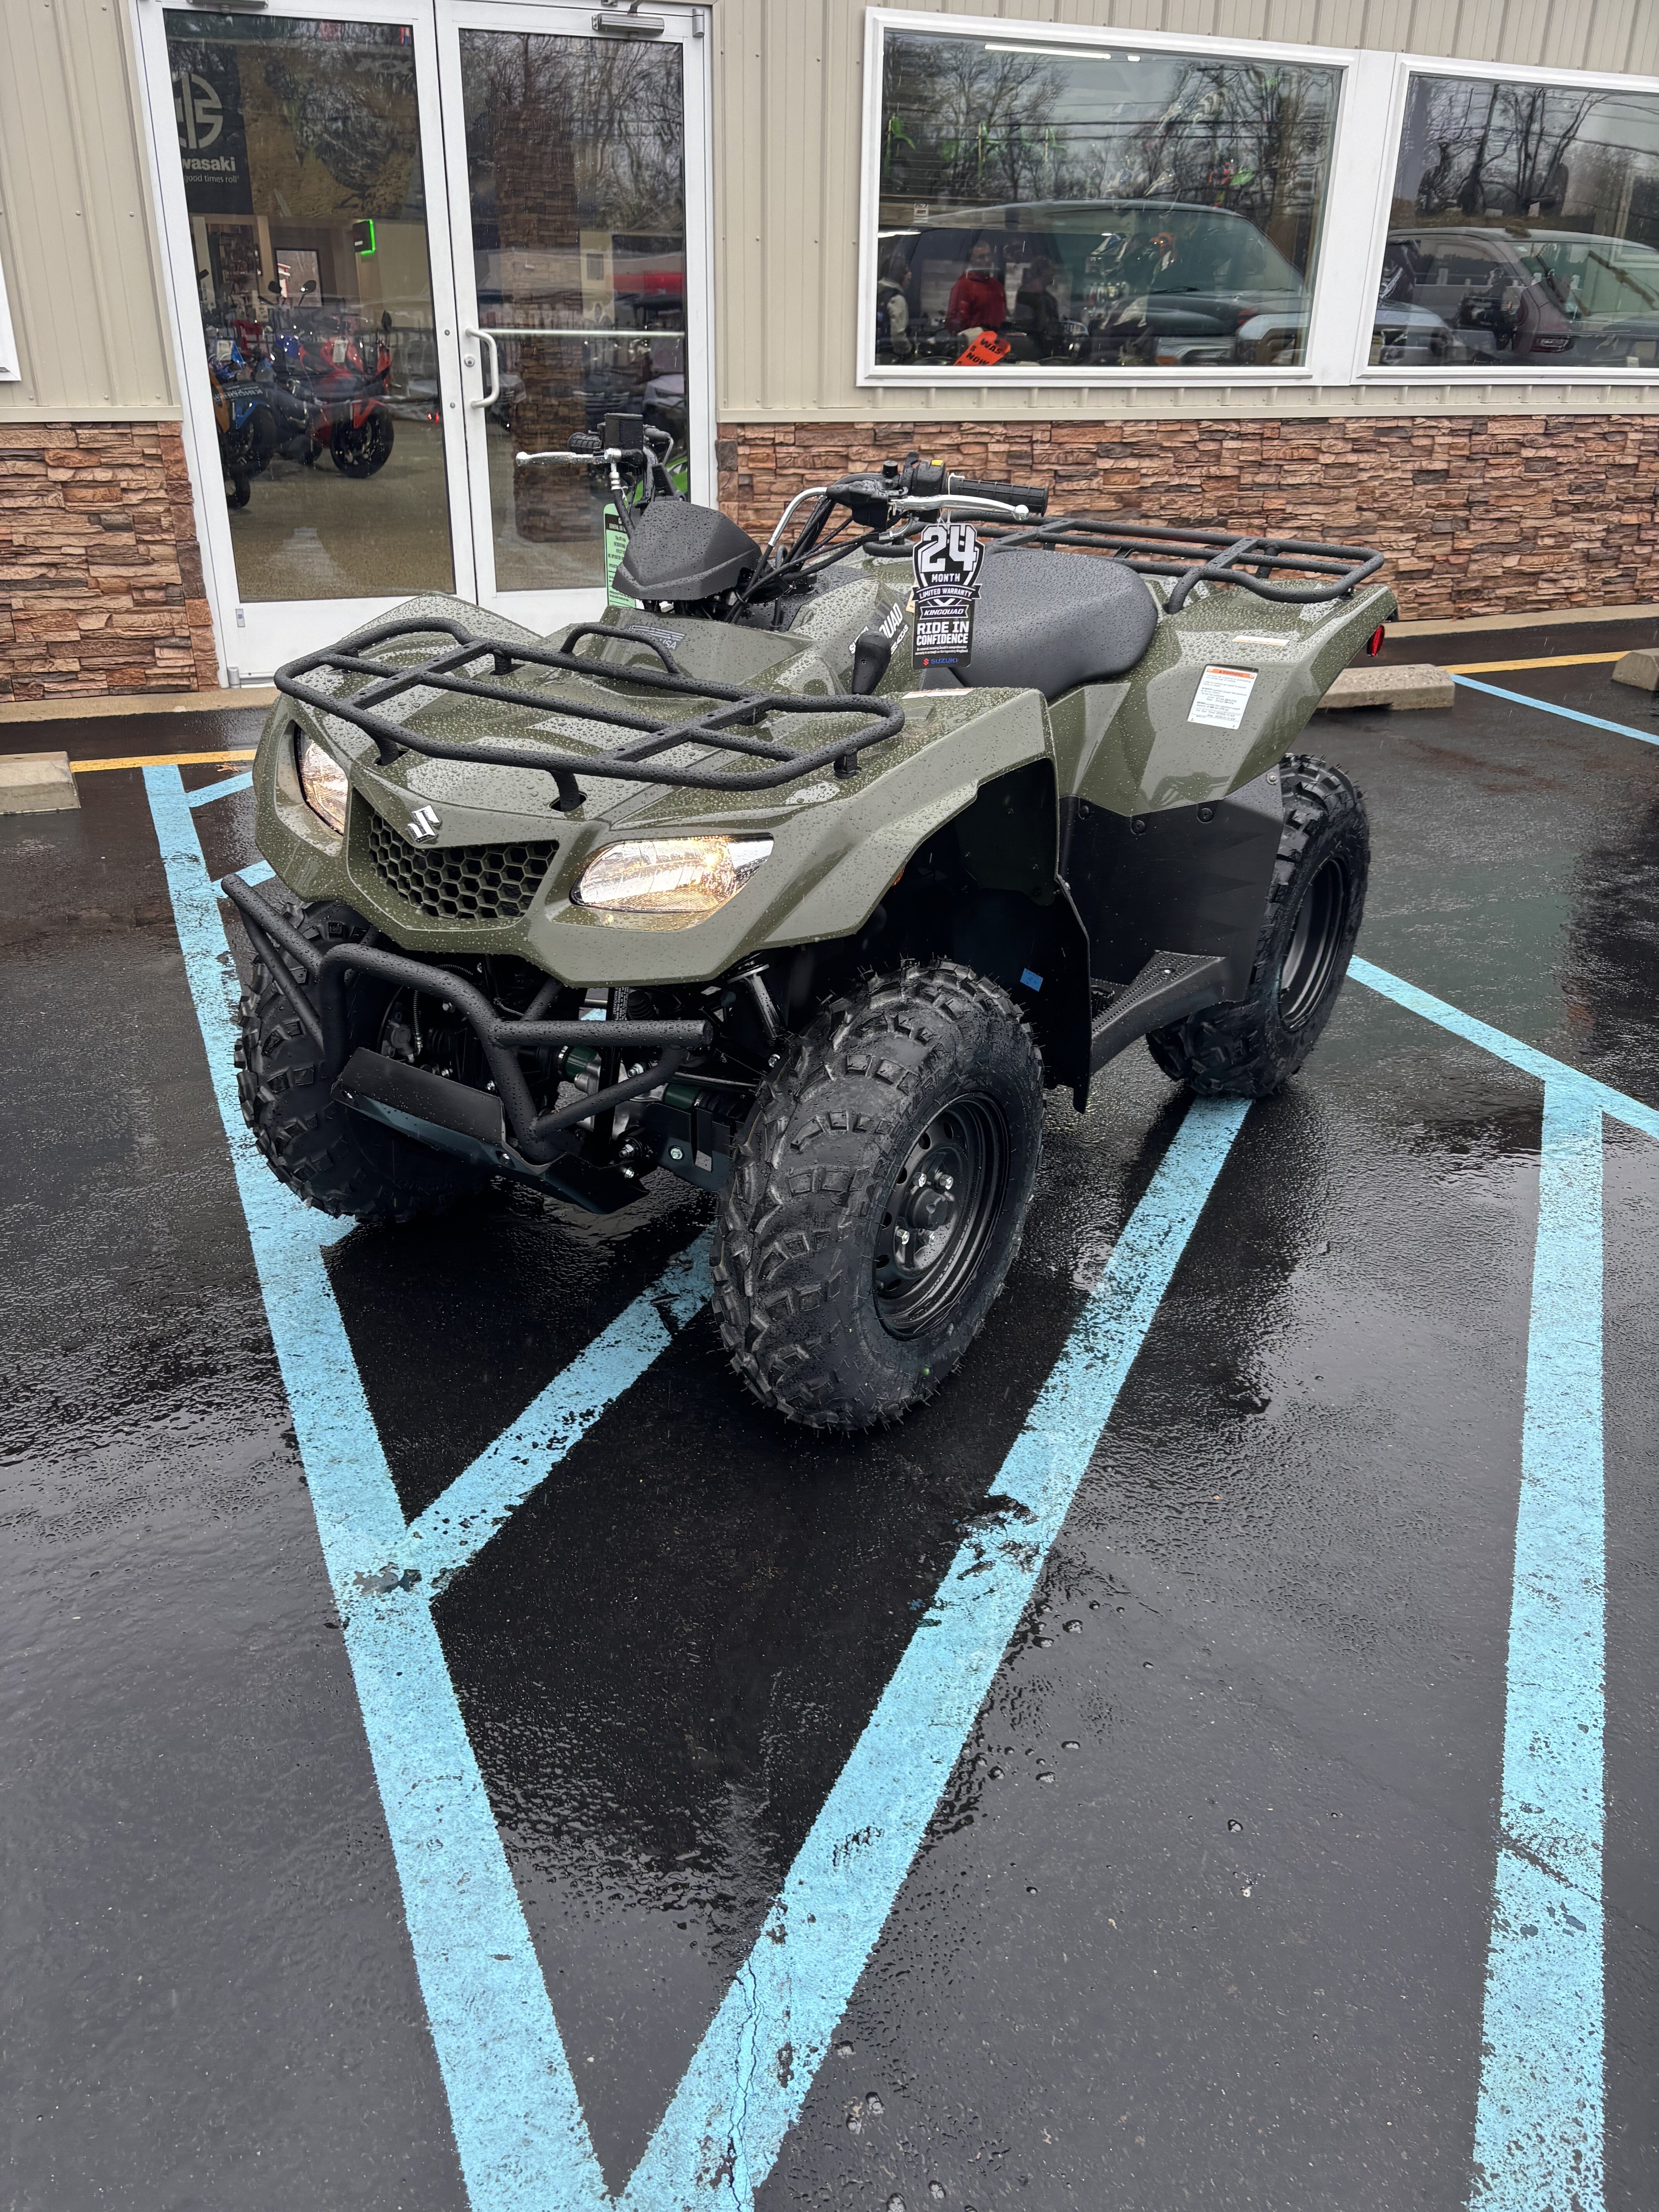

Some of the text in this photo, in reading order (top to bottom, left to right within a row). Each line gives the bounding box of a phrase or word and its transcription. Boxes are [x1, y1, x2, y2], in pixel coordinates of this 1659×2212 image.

[182, 156, 236, 171] wasaki
[204, 175, 223, 183] times
[981, 338, 1003, 354] WAS
[921, 526, 977, 572] 24
[931, 573, 960, 582] MONTH
[919, 588, 972, 599] LIMITED WARRANTY
[917, 621, 969, 635] RIDE IN
[916, 633, 969, 646] CONFIDENCE
